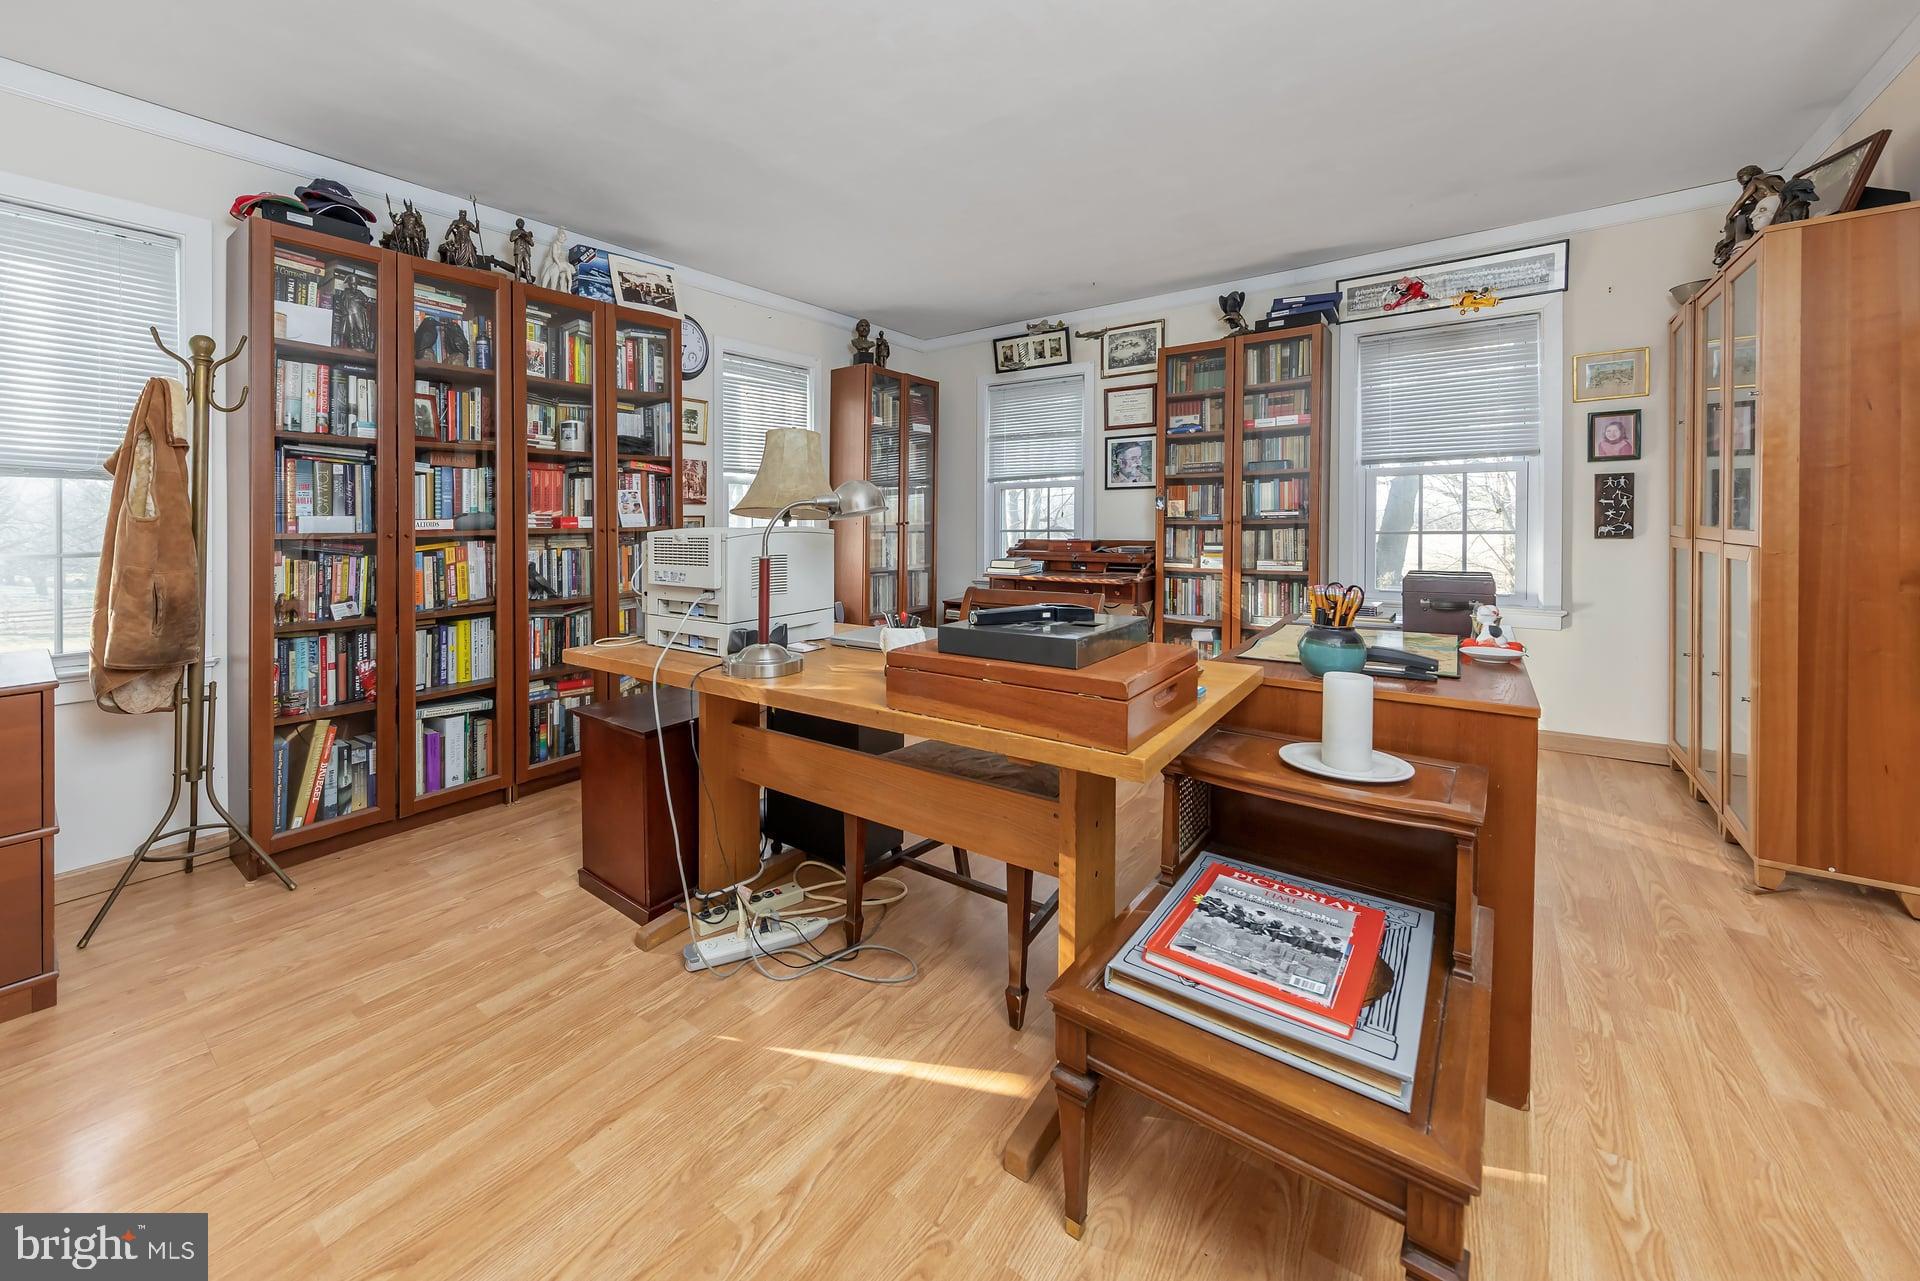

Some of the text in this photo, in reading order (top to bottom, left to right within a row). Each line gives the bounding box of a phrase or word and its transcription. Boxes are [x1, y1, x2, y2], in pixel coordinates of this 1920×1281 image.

[309, 640, 318, 664] Faster
[312, 762, 328, 804] BRUEGEL
[1222, 885, 1340, 924] 100 Photographs
[1232, 871, 1361, 914] PICTORIAL
